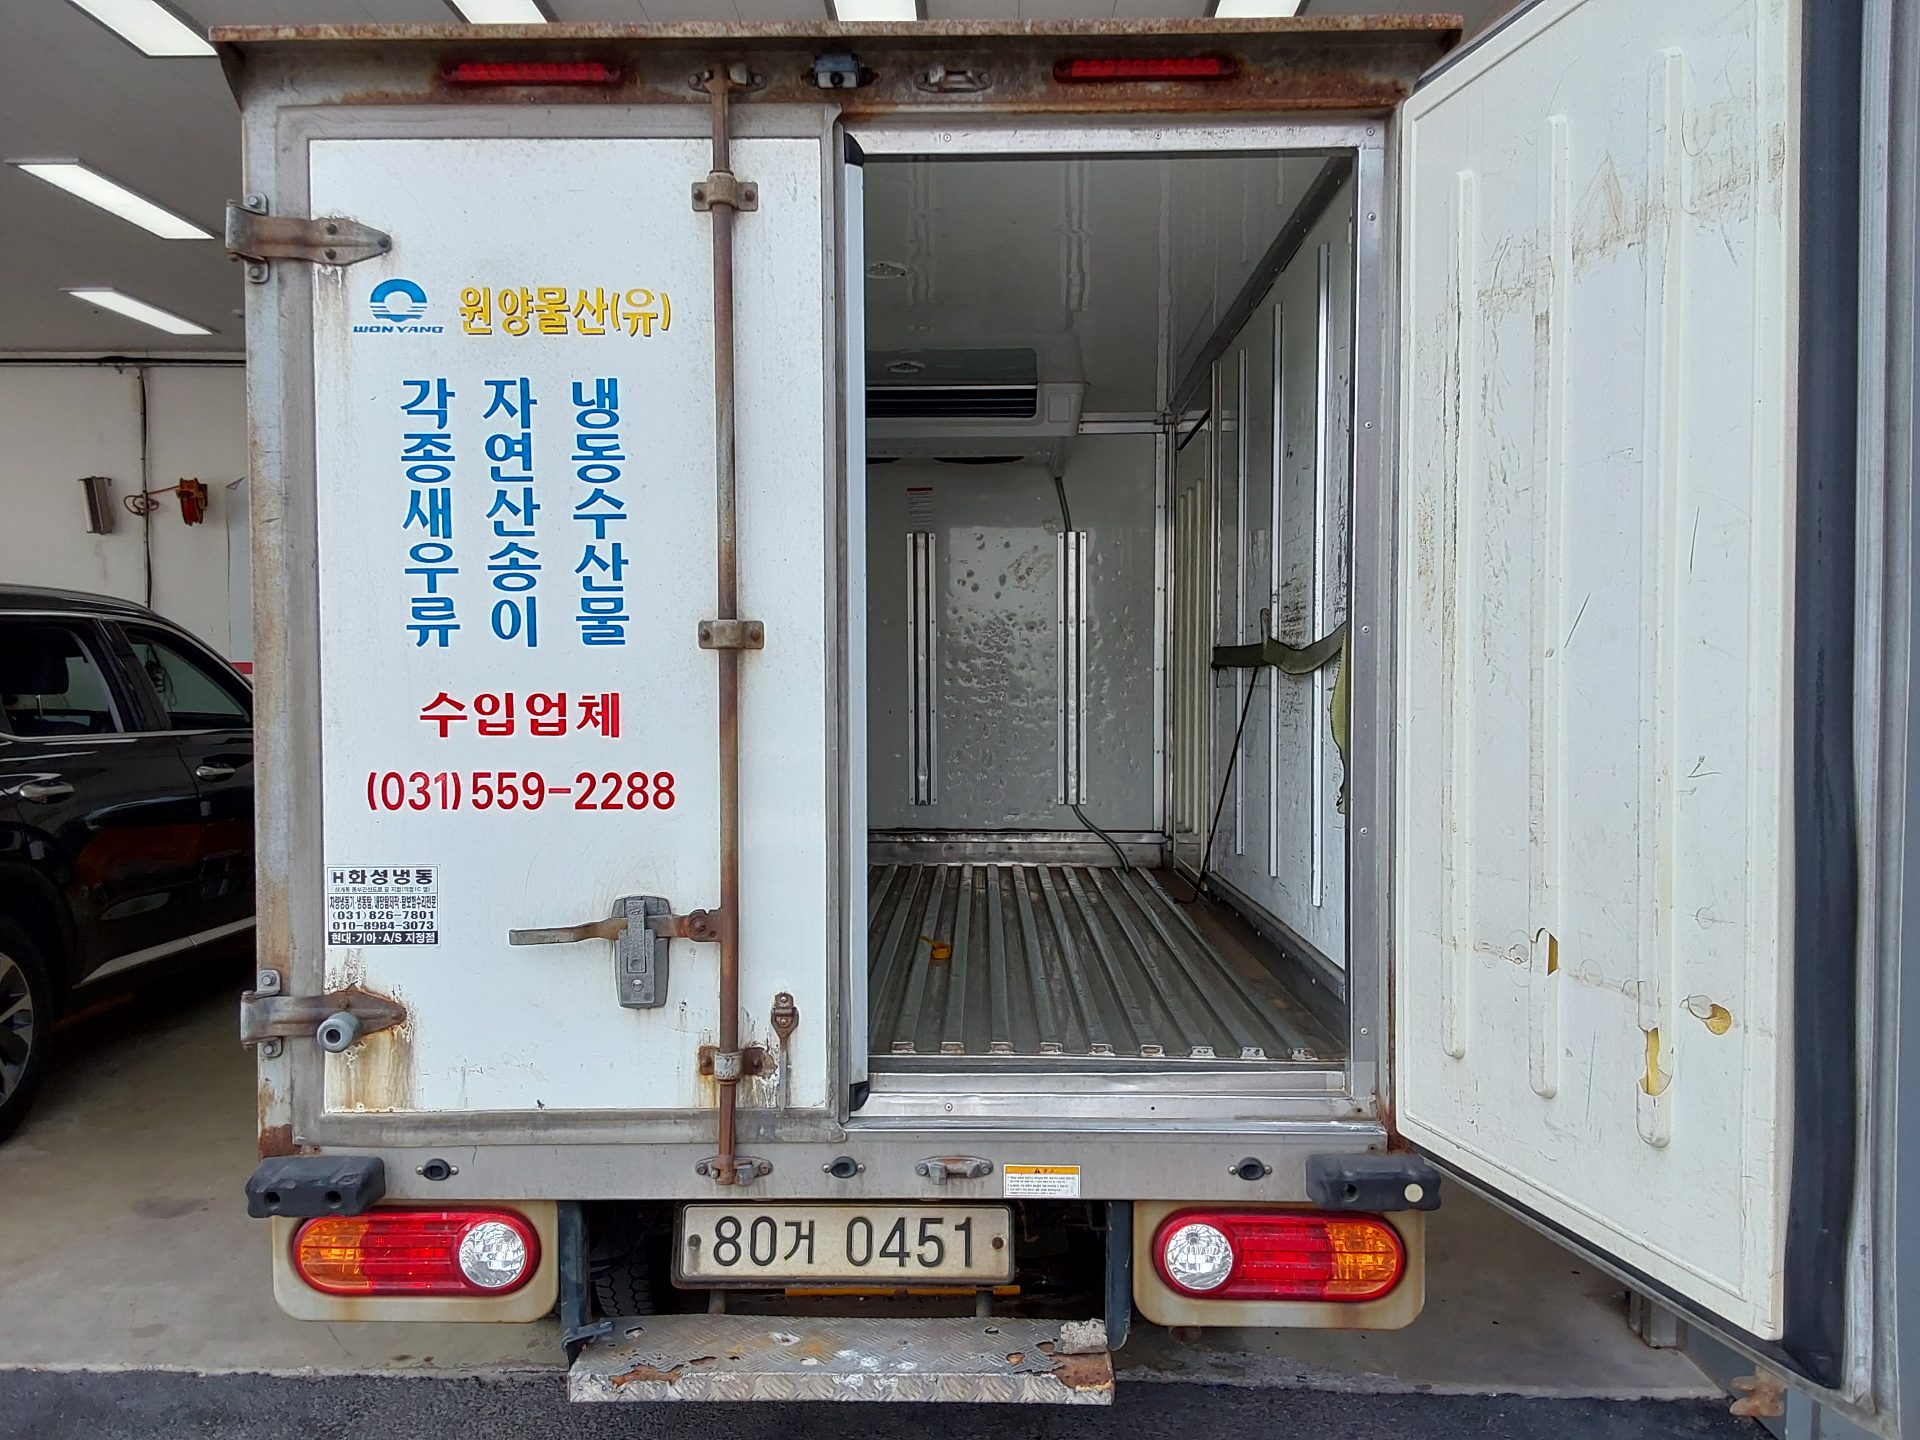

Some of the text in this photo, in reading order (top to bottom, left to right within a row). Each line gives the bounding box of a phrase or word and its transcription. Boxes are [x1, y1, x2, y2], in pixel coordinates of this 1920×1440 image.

[459, 286, 671, 337] 원양물산(유)
[419, 692, 621, 738] 수입업체
[367, 771, 676, 811] (031)559-2288
[348, 869, 433, 885] 화성냉동
[332, 921, 434, 930] 010-8984-3073
[405, 933, 435, 944] 지정점
[846, 1216, 973, 1268] 0451
